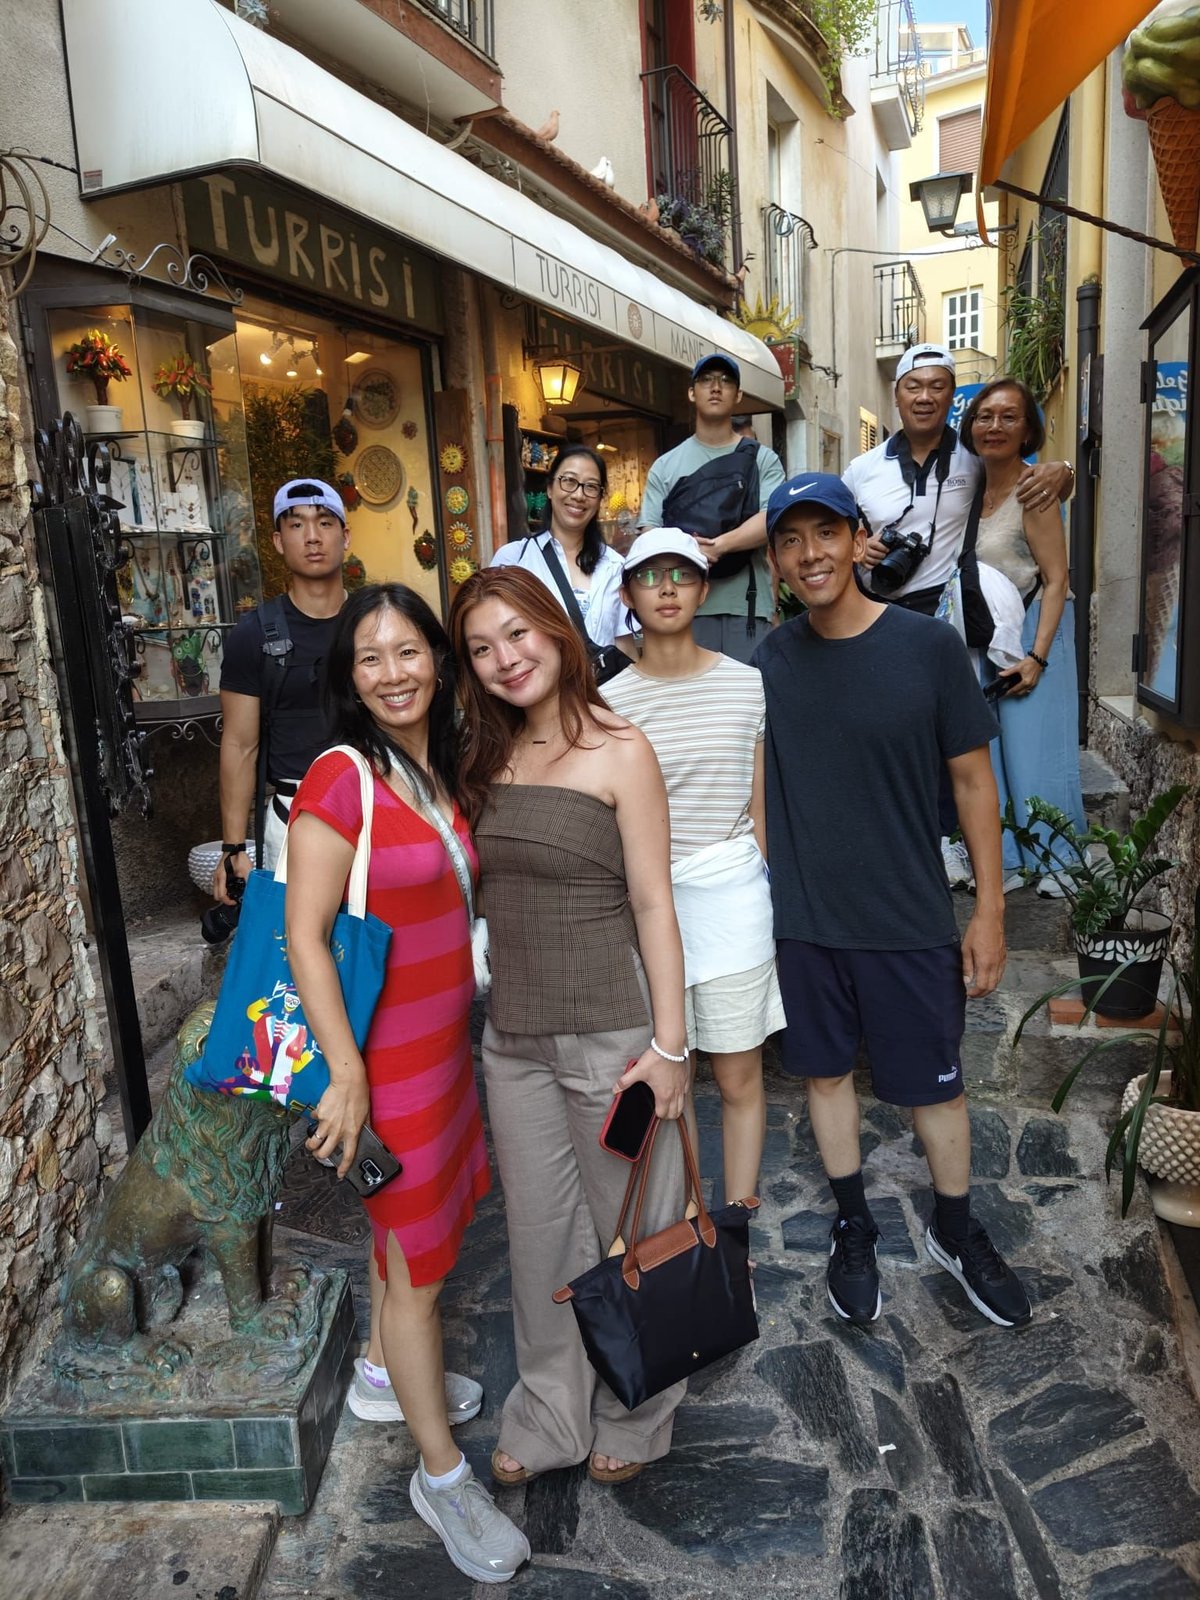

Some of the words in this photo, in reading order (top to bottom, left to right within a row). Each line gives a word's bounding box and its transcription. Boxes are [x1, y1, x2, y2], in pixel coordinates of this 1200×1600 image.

[536, 252, 602, 321] TURRISI
[946, 479, 966, 487] BOSS
[938, 1071, 957, 1083] PUMA
